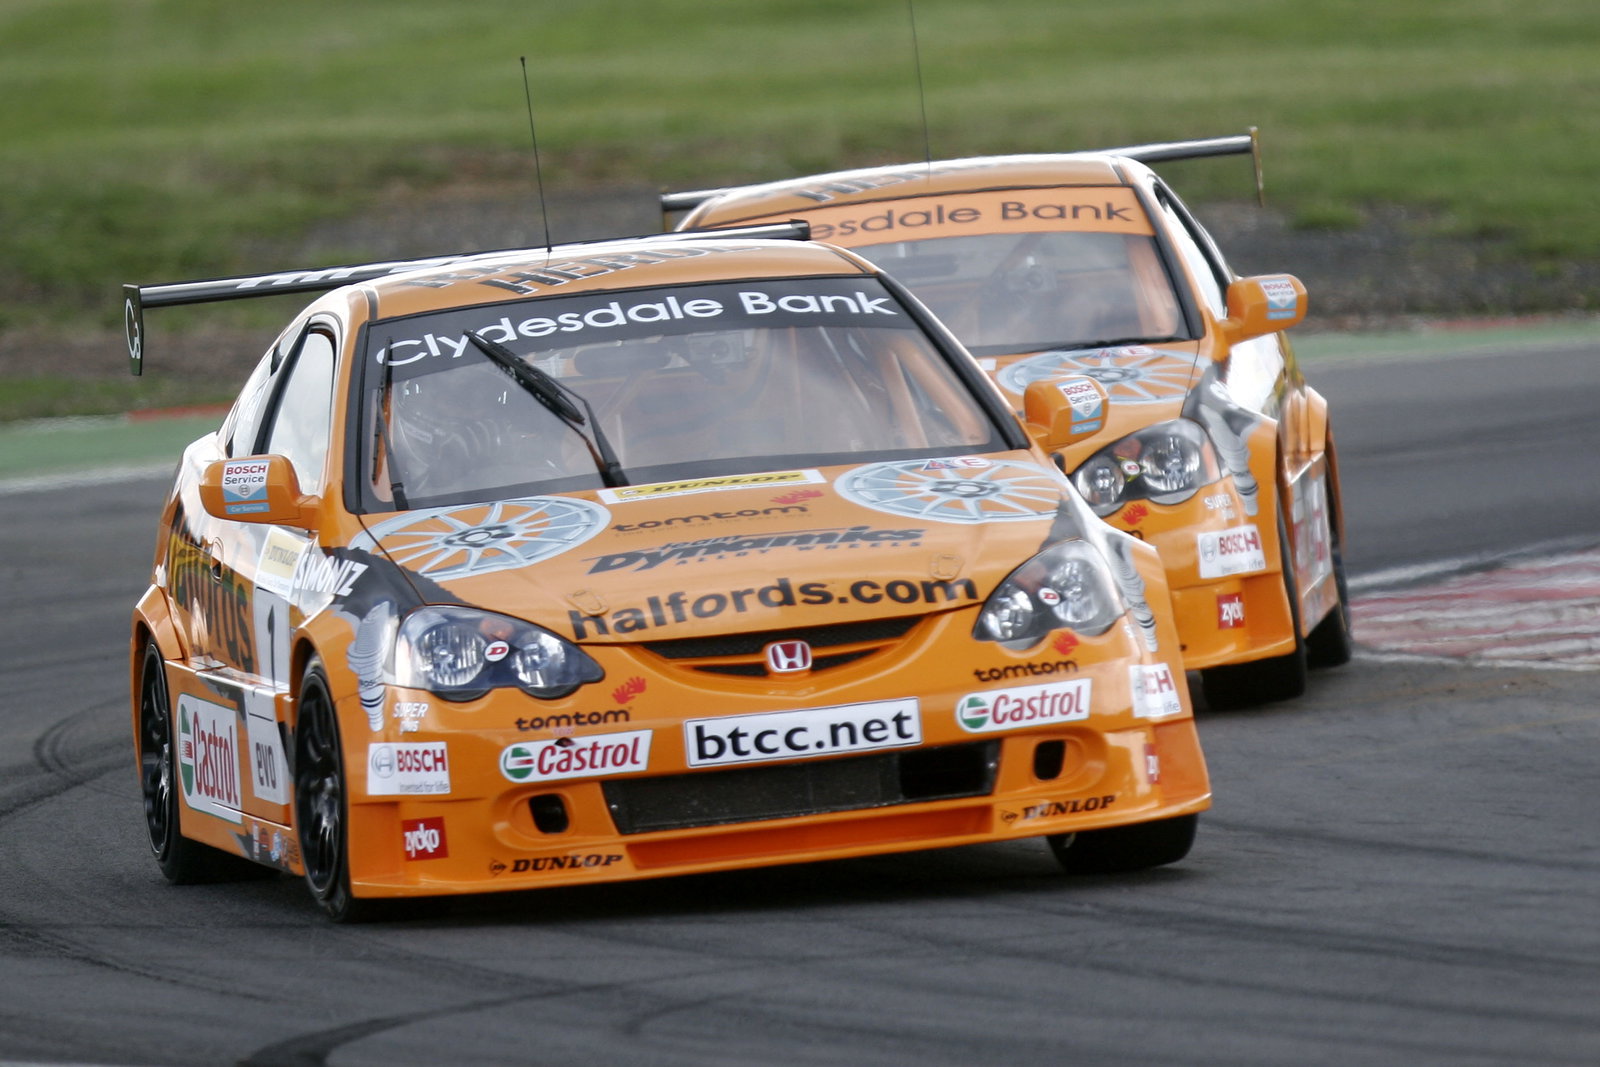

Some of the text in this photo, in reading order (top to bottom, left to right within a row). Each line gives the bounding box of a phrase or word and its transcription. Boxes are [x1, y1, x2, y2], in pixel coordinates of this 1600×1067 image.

[810, 201, 1134, 241] esdale Bank
[376, 291, 898, 367] Clydesdale Bank
[1063, 384, 1093, 396] BOSCH
[1070, 393, 1099, 405] Service
[224, 474, 265, 485] Service
[226, 465, 266, 475] BOSCH
[653, 474, 801, 492] DUNLOP
[611, 504, 809, 532] tomtom
[585, 525, 926, 575] Dynamics
[1219, 531, 1261, 556] BOSCH
[295, 552, 369, 597] SIMONIZ
[568, 577, 978, 641] halfords.com
[974, 660, 1078, 682] tomtom
[392, 702, 429, 718] SUPER
[992, 685, 1083, 725] Castrol
[515, 709, 630, 731] tomtom
[695, 710, 913, 760] btcc.net
[193, 711, 239, 805] Castrol
[255, 742, 277, 790] evo
[397, 748, 446, 773] BOSCH
[537, 736, 641, 775] Castrol
[1023, 794, 1116, 820] DUNLOP
[511, 853, 623, 874] DUNLOP
